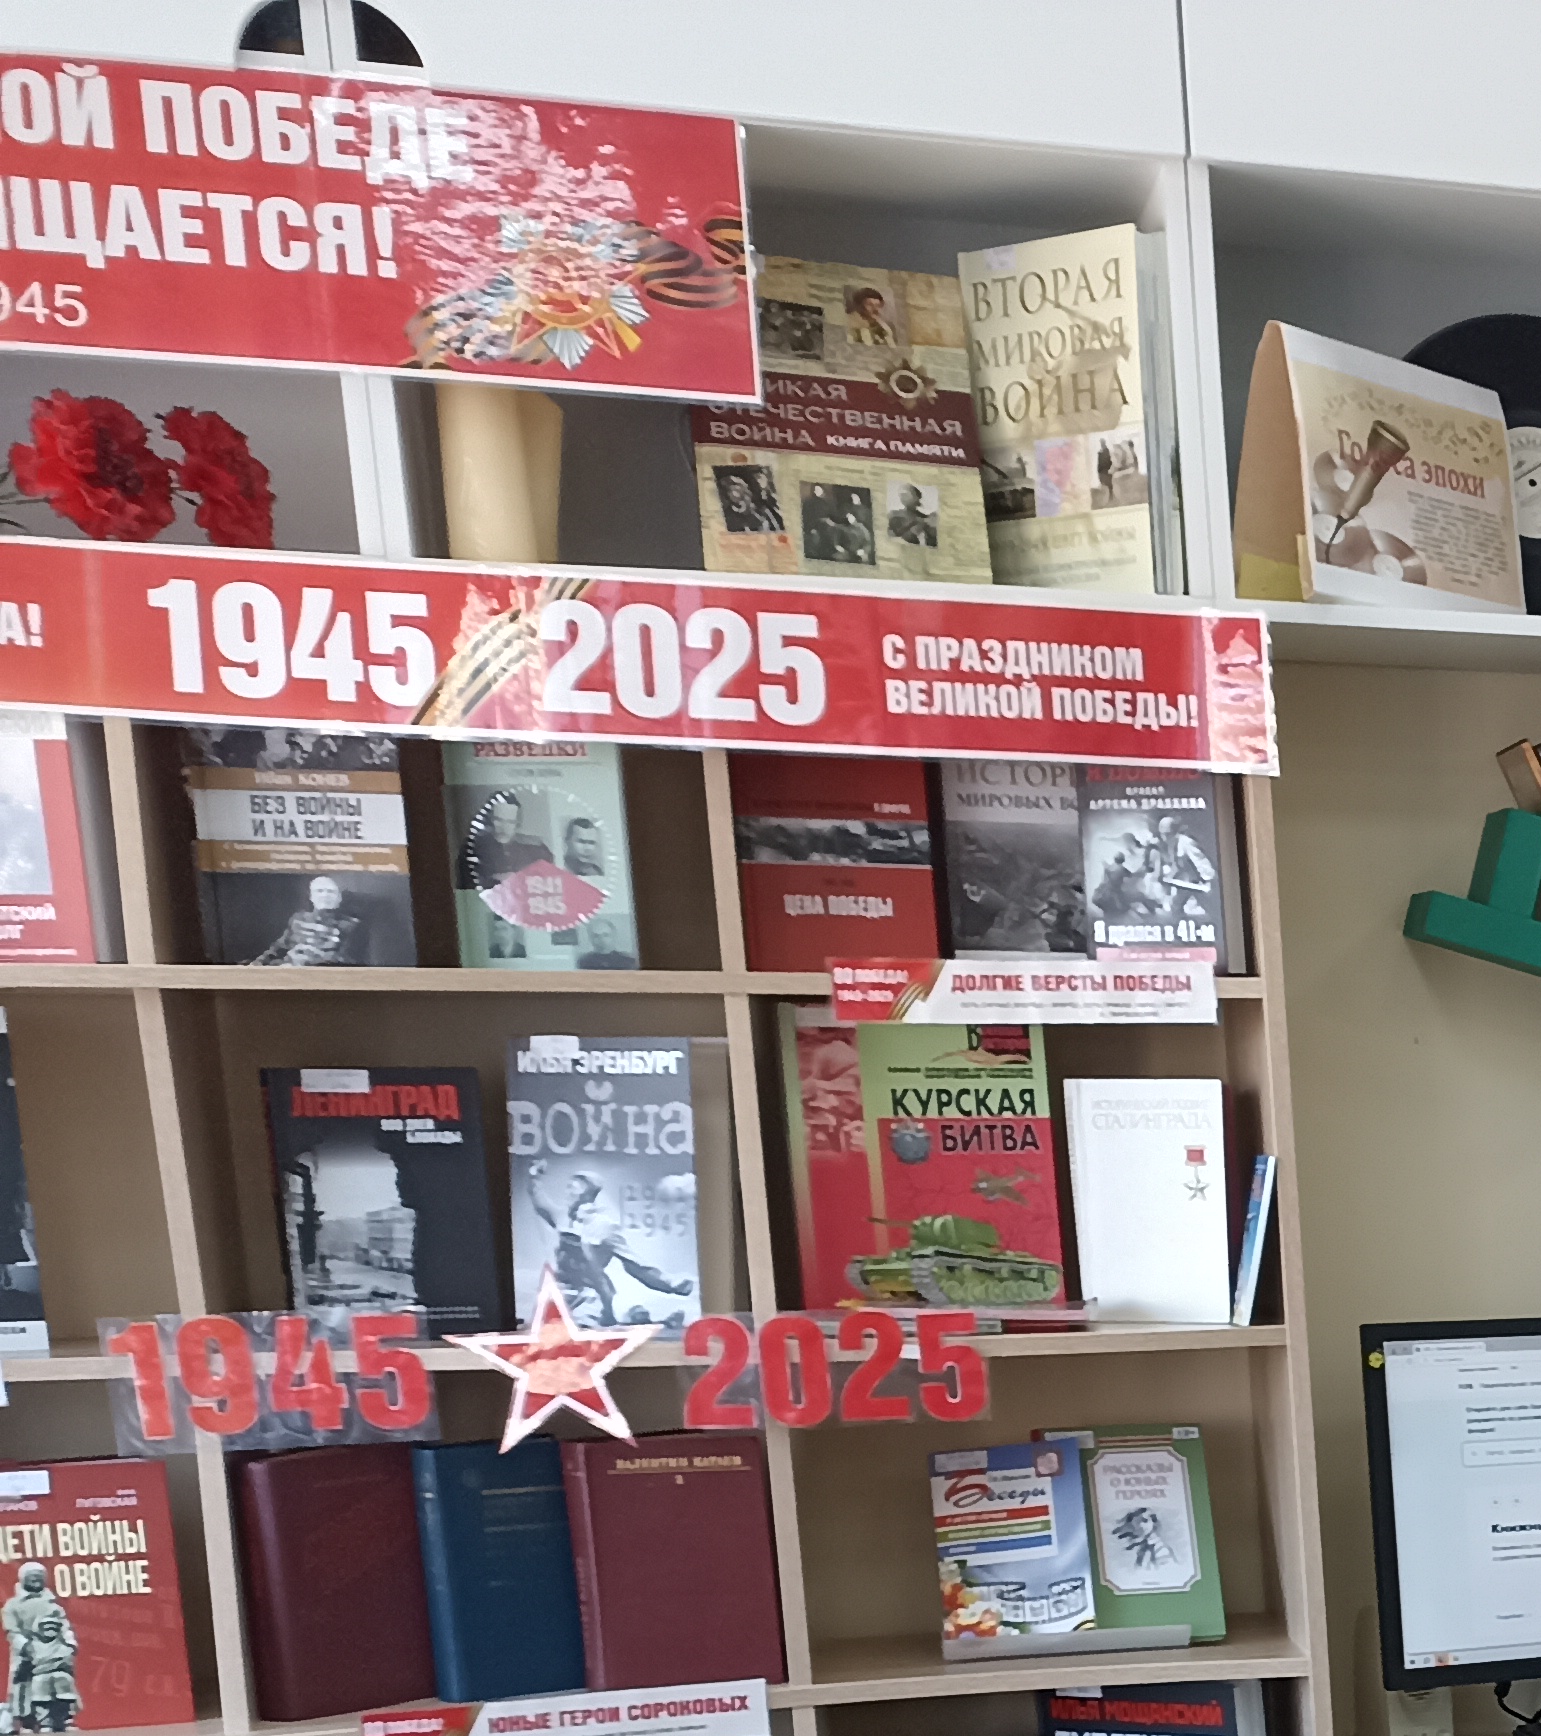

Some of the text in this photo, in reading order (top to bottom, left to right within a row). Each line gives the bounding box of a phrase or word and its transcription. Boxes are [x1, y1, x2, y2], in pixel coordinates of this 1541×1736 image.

[1, 63, 473, 189] ОЙ ПОБЕДЕ
[971, 257, 1124, 322] ВТОРАЯ
[973, 316, 1127, 374] МИРОВАЯ
[977, 354, 1131, 428] ВОЙНА
[709, 421, 967, 460] ВОЙНА КНИГА ПАМЯТИ
[1420, 459, 1487, 500] эпохи
[147, 578, 437, 707] 1945
[541, 600, 826, 727] 2025
[882, 633, 1145, 684] С ПРАЗДНИКОМ
[885, 677, 1200, 733] ВЕЛИКОЙ ПОБЕДЫ!
[250, 791, 362, 816] БЕЗ ВОЙНЫ
[252, 816, 364, 839] И НА ВОЙНЕ
[828, 894, 894, 918] ПОБЕДЫ
[951, 973, 1193, 994] ДОЛГИЕ ВЕРСТЫ ПОБЕДЫ
[574, 1050, 685, 1075] ЭРЕНБУРГ
[890, 1087, 1037, 1117] КУРСКАЯ
[939, 1123, 1040, 1152] БИТВА
[108, 1311, 990, 1440] 1945 2025
[1102, 1462, 1173, 1476] РАССКАЗЫ
[56, 1513, 147, 1557] ВОЙНЫ
[53, 1554, 152, 1598] О ВОЙНЕ
[487, 1694, 750, 1734] ЮНЫЕ ГЕРОИ СОРОКОВЫХ
